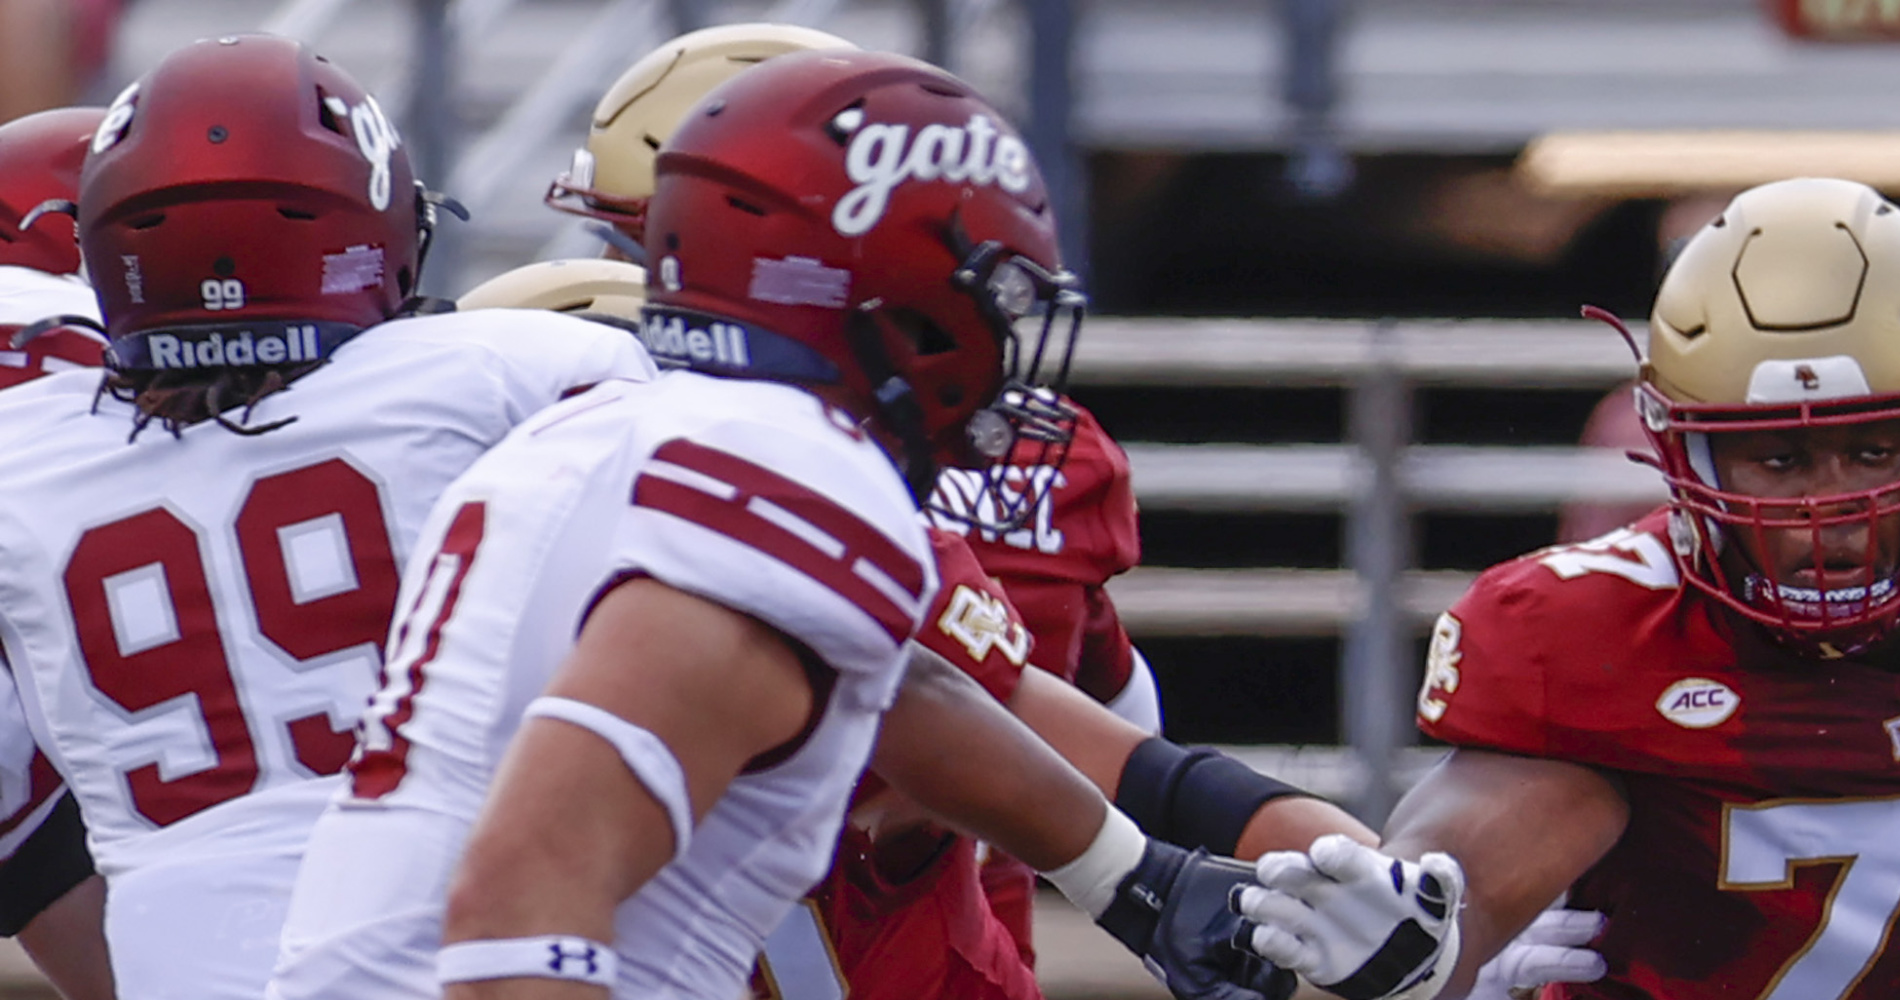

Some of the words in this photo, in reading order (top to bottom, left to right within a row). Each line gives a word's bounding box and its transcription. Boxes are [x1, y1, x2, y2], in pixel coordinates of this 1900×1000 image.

[202, 279, 244, 310] 99
[149, 325, 318, 368] Riddell
[62, 457, 400, 827] 99
[1670, 688, 1725, 710] ACC
